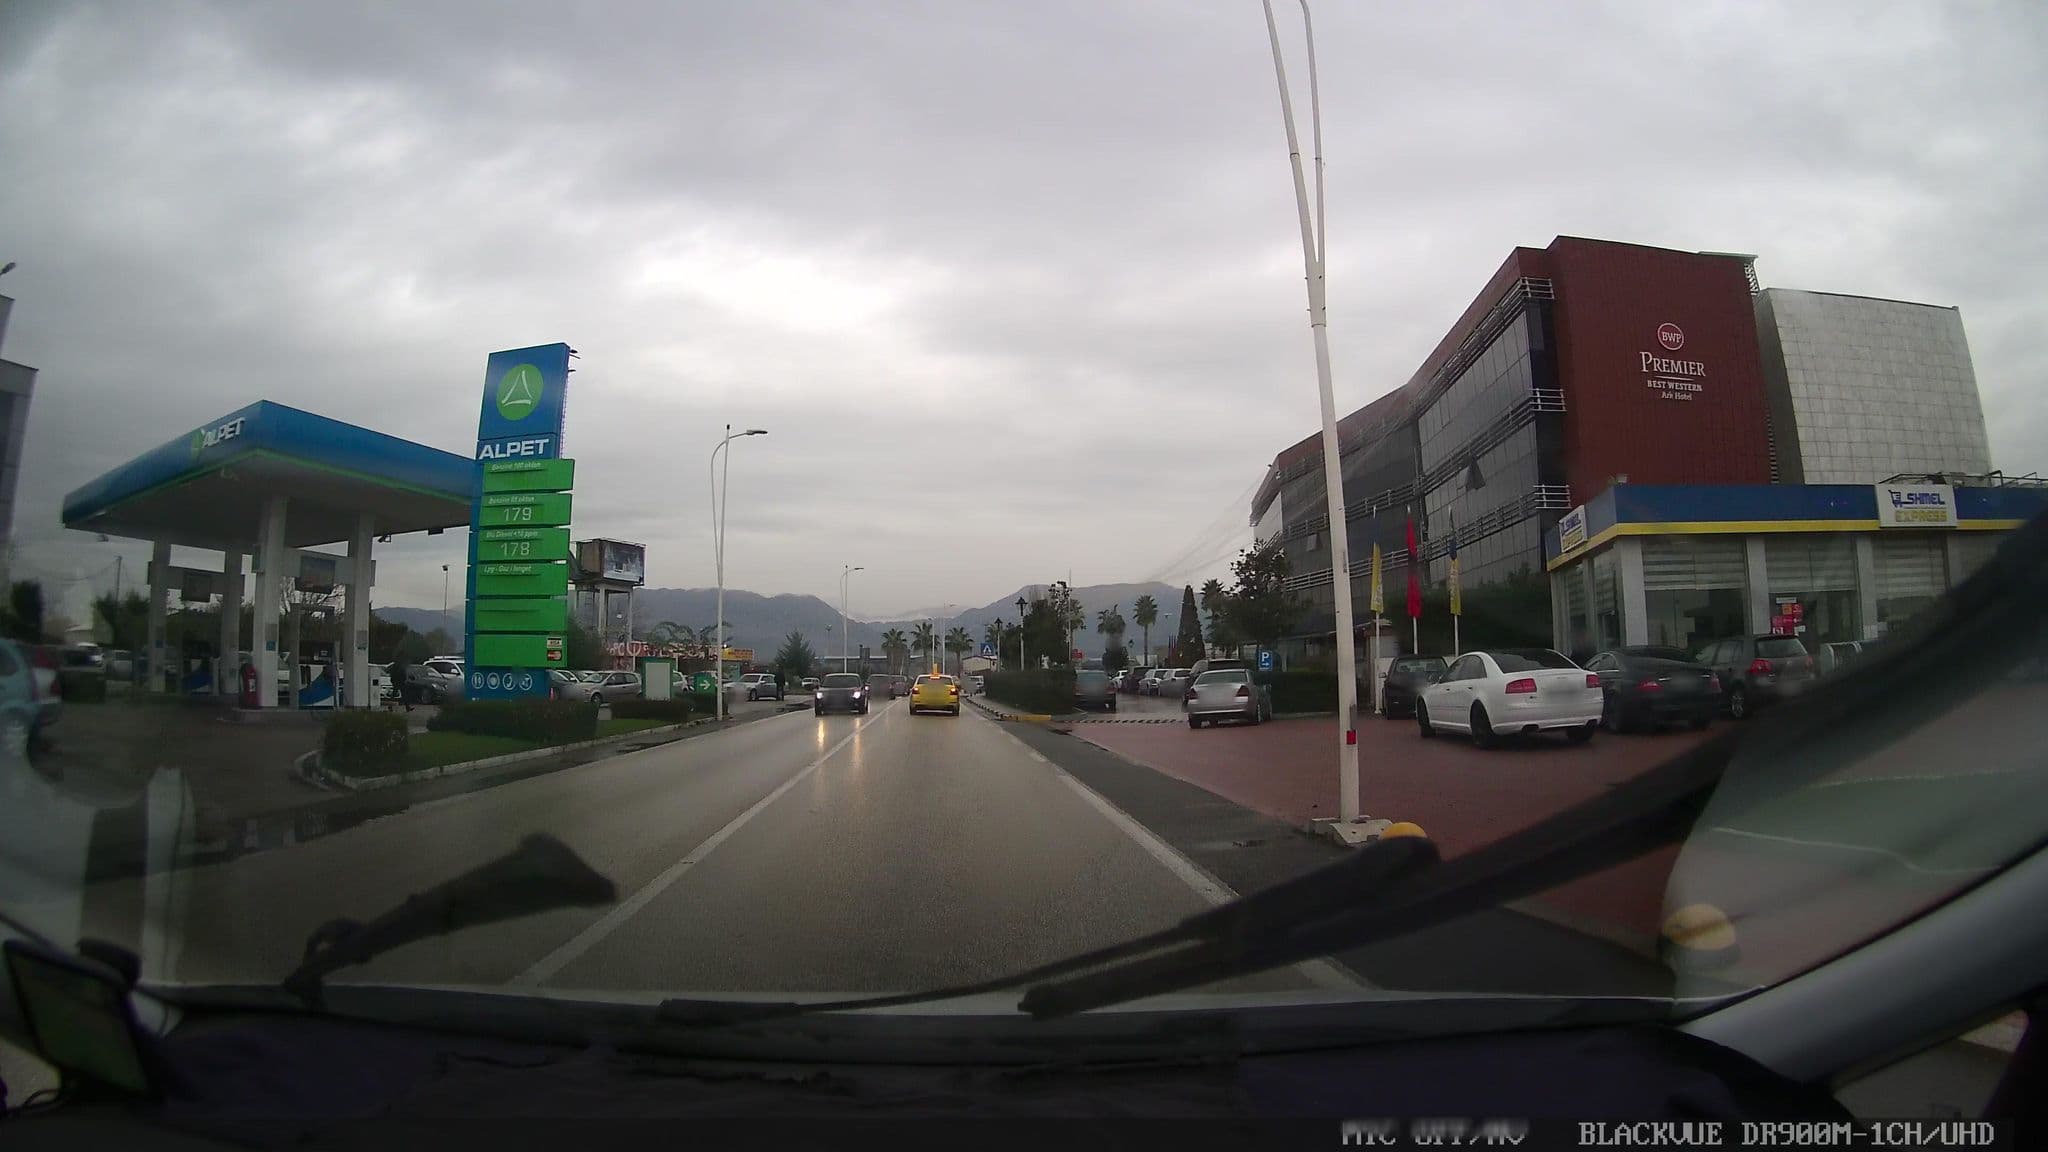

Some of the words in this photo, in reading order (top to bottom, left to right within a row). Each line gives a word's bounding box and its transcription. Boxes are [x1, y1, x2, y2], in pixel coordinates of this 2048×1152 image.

[1661, 332, 1682, 343] BWP
[1640, 351, 1706, 377] PREMIER
[1647, 380, 1667, 389] BEST
[1667, 381, 1703, 391] WESTERN
[1674, 392, 1693, 400] Hotel
[202, 417, 246, 448] ALPET
[478, 439, 549, 460] ALPET
[1906, 493, 1946, 505] SHMEL
[503, 507, 532, 521] 179
[1895, 510, 1947, 522] EXPRESS
[501, 542, 530, 557] 178
